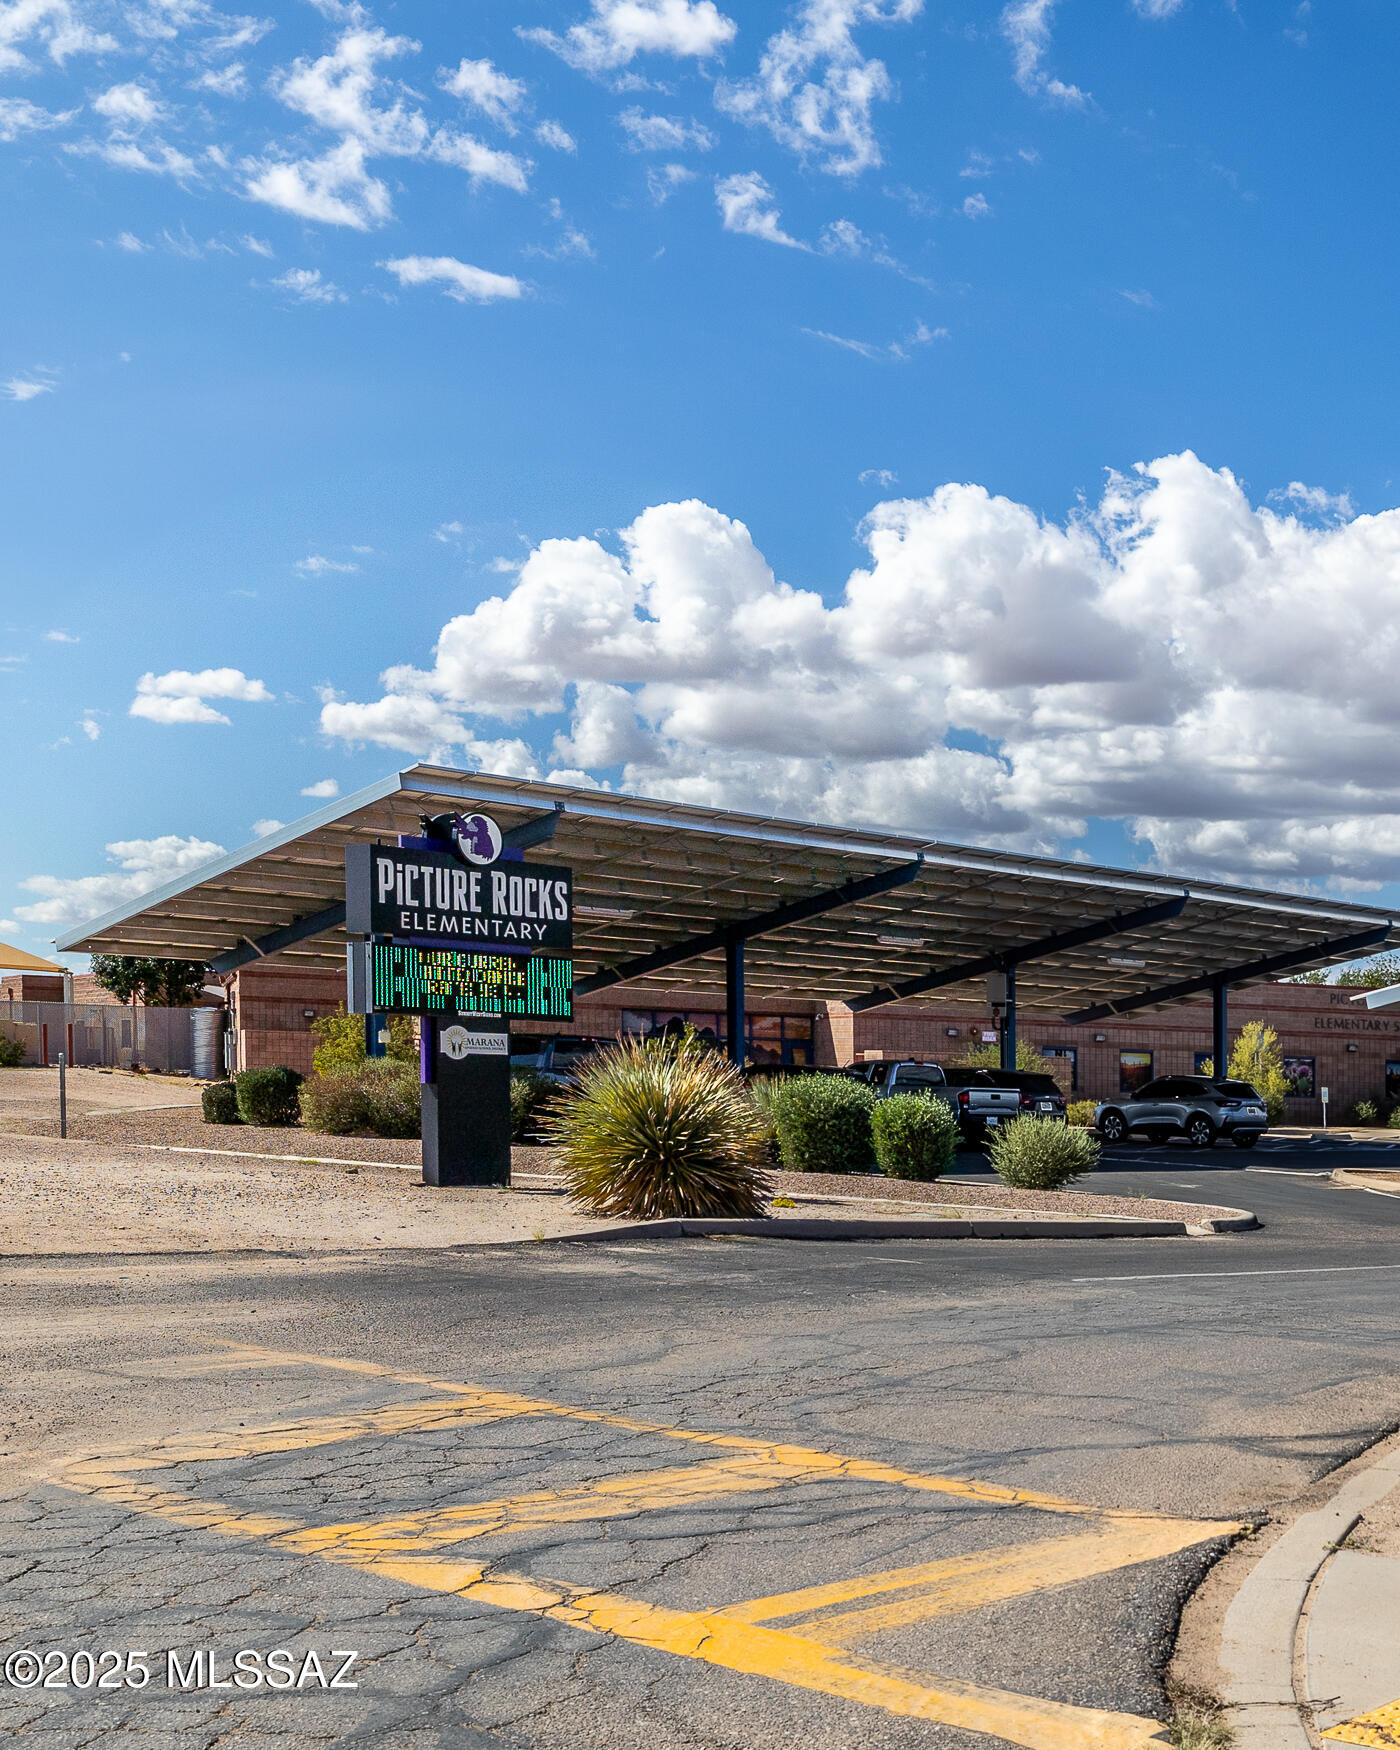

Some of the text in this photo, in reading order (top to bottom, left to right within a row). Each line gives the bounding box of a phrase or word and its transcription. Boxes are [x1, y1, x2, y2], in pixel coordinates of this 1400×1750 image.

[490, 870, 568, 921] ROCKS
[401, 911, 548, 941] ELEMENTARY
[1314, 1017, 1390, 1032] ELEMENTARY
[465, 1037, 505, 1048] MARANA
